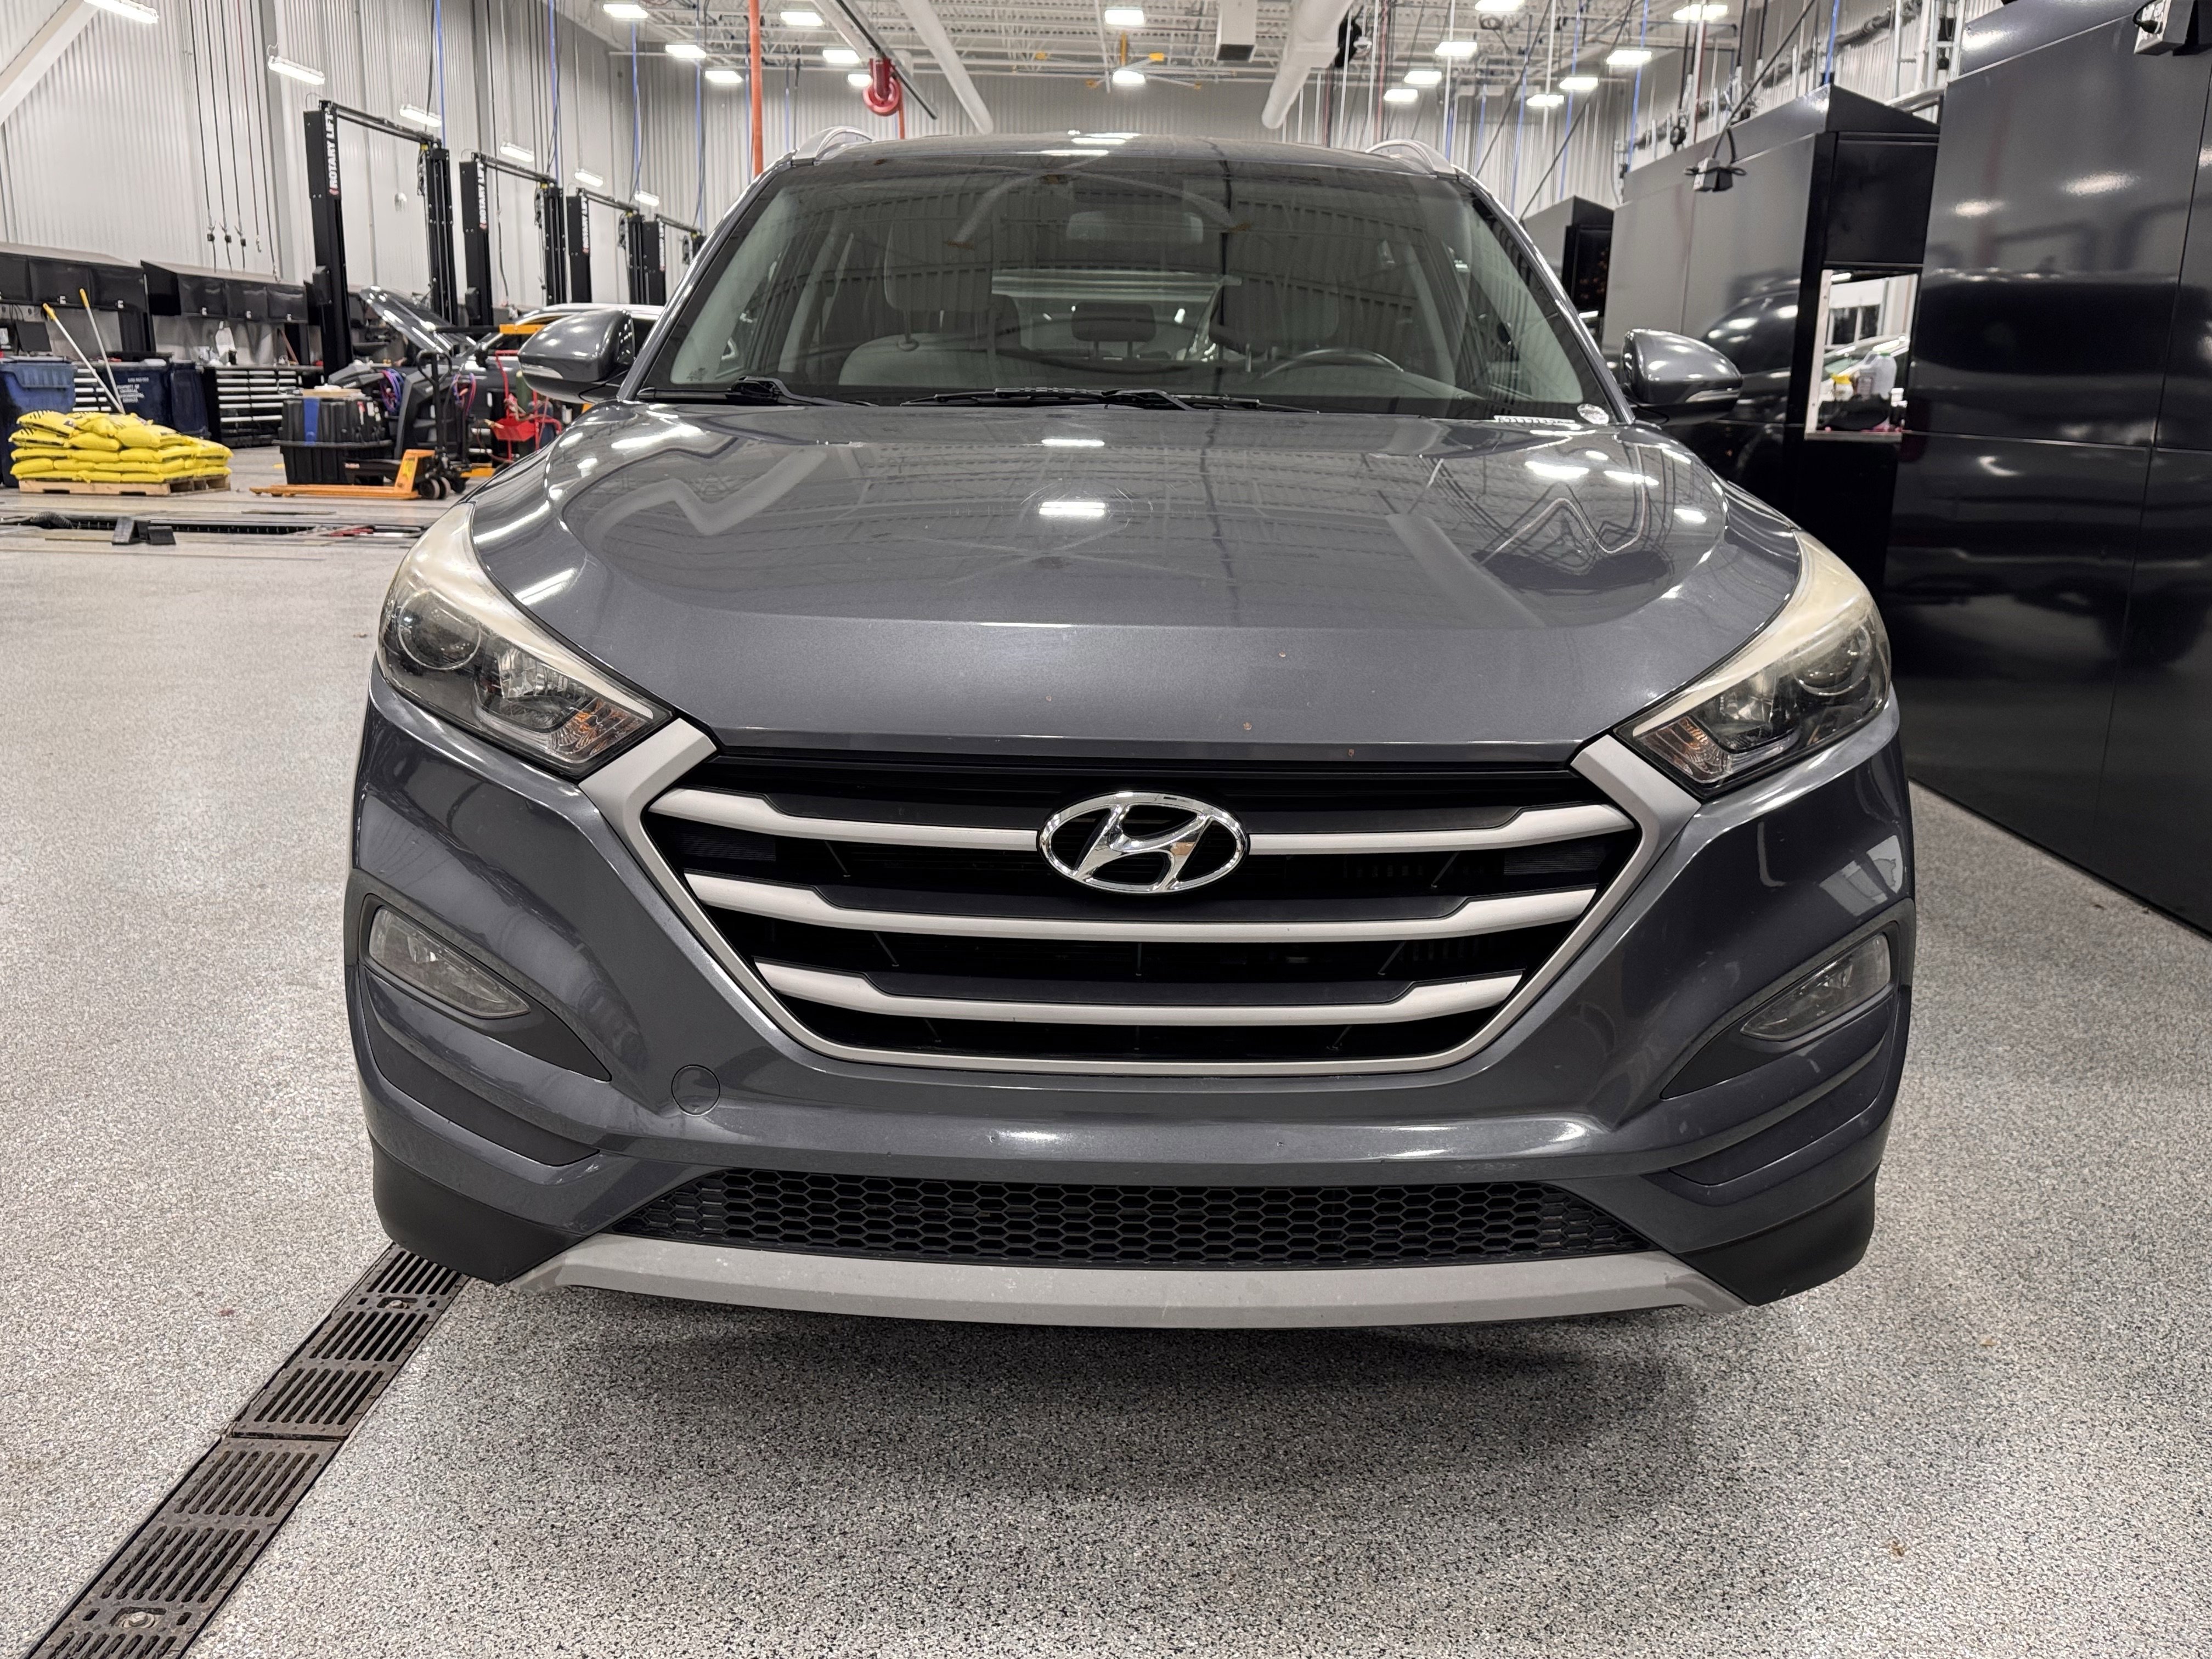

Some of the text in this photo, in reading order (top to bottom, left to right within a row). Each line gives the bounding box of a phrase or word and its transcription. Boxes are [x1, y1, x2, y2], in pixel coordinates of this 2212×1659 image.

[325, 112, 338, 189] ROTARY LIFT
[477, 161, 487, 223] ROTARY LIFT
